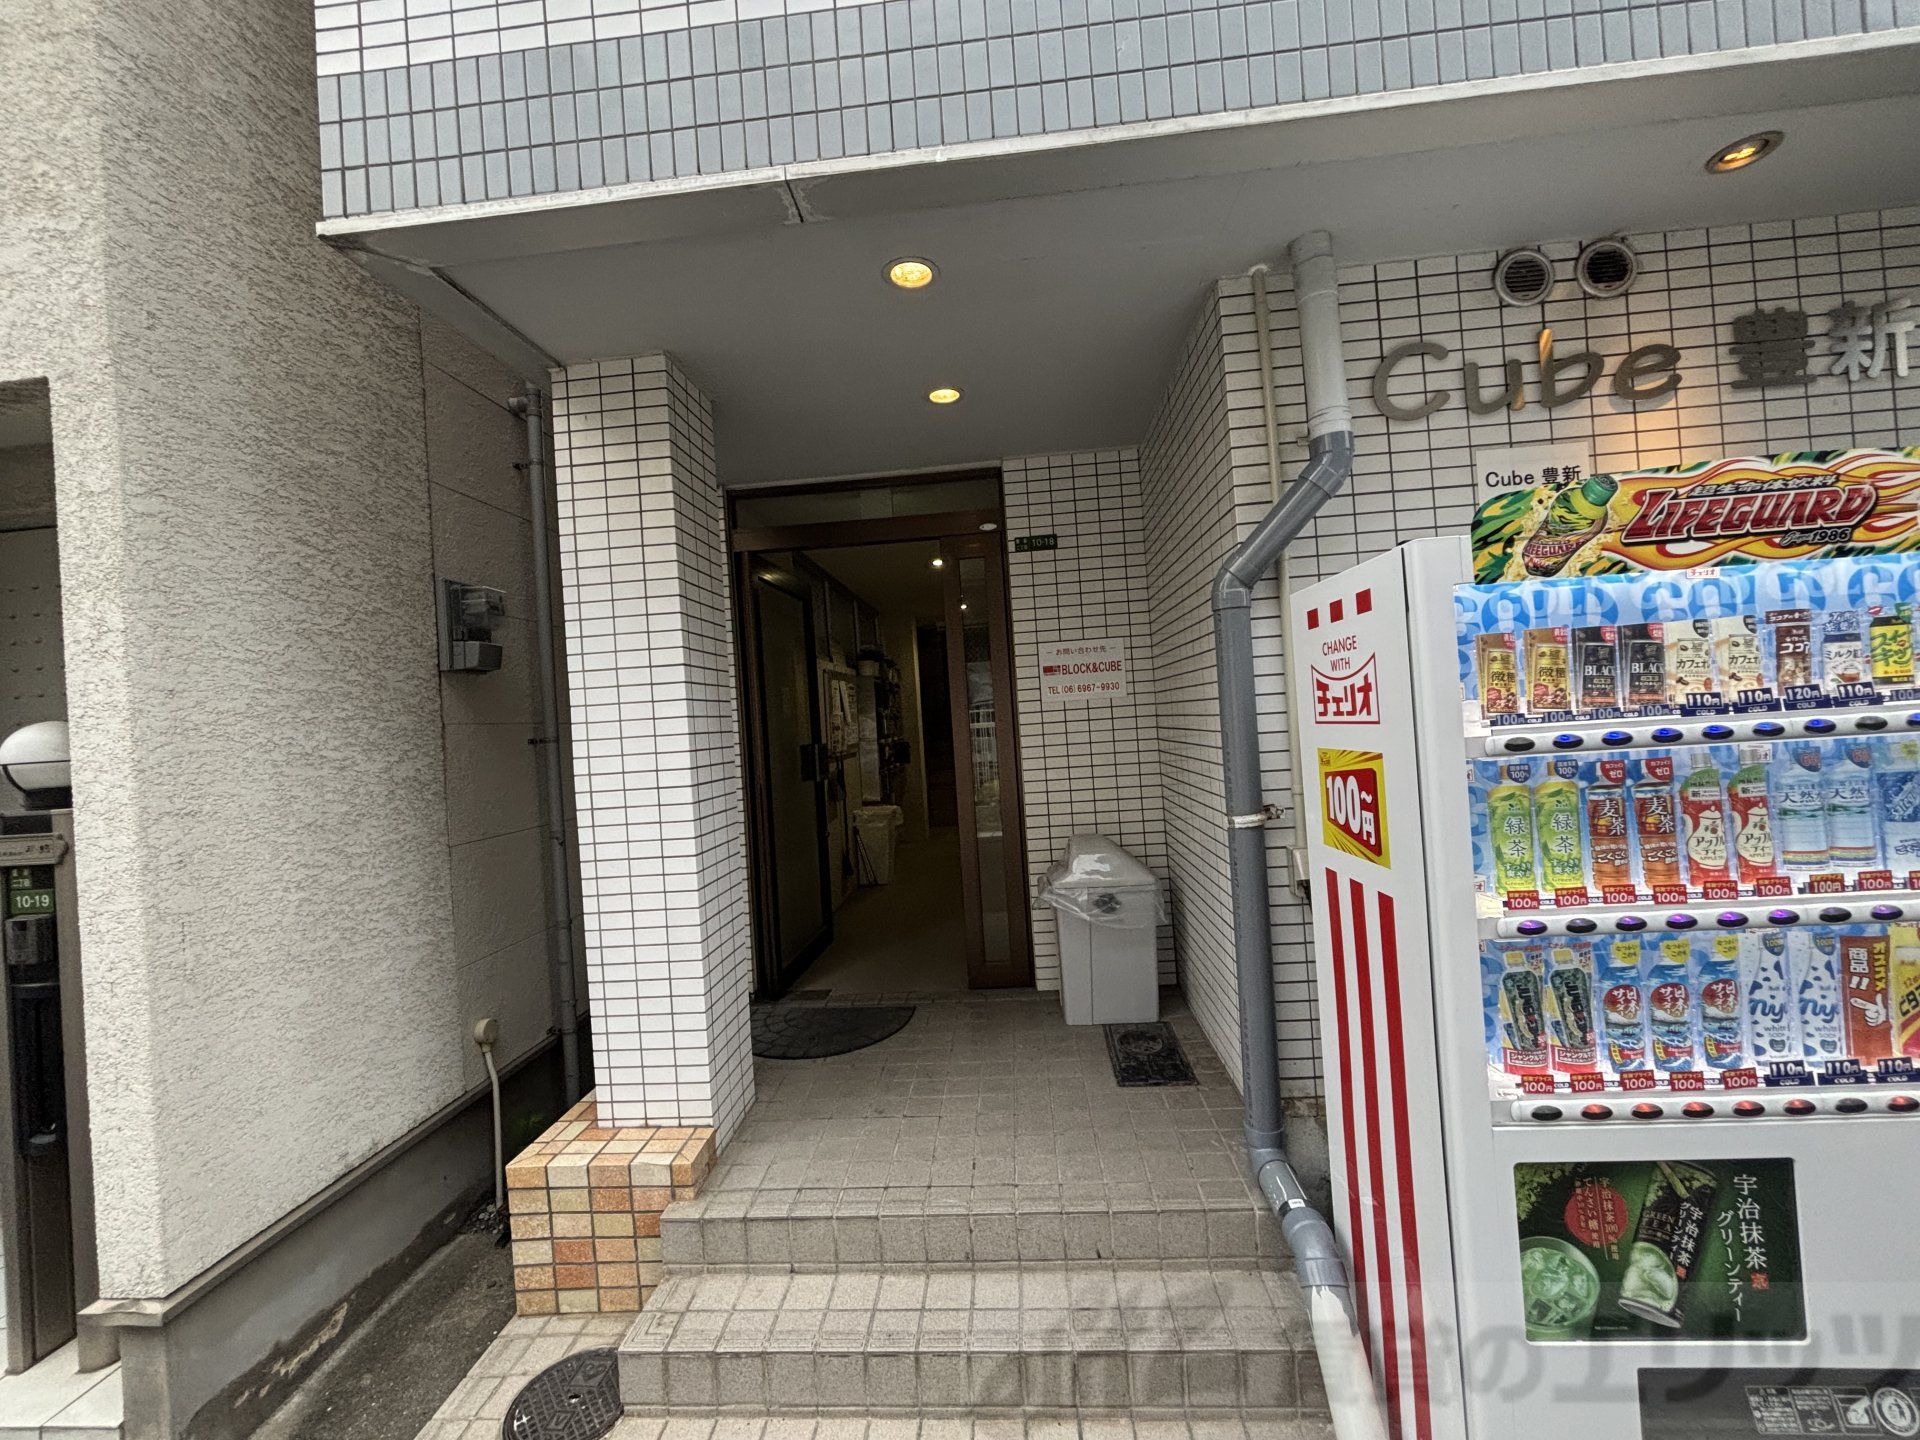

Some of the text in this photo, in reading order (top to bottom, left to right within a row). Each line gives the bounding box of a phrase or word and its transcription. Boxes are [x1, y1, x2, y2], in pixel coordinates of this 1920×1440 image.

[1373, 298, 1914, 421] Cube 豊新
[1485, 465, 1582, 488] Cube 豊新
[1690, 474, 1838, 498] 超生命体飲料
[1622, 483, 1877, 543] LIFEGUARD
[1811, 529, 1850, 544] 1986
[1322, 635, 1358, 657] CHANGE
[1061, 660, 1123, 676] BLOCK&CUBE
[1330, 657, 1351, 672] WITH
[1048, 686, 1061, 695] TEL
[1316, 673, 1373, 717] チェリオ
[1786, 688, 1820, 701] 120円
[1838, 685, 1871, 698] 110円
[1687, 695, 1720, 707] 110円
[1739, 691, 1771, 704] 110円
[1609, 770, 1623, 778] ゼロ
[1656, 767, 1670, 775] ゼロ
[1599, 800, 1625, 836] 麦茶
[1645, 798, 1675, 835] 麦茶
[1505, 817, 1527, 857] 緑茶
[1552, 814, 1574, 854] 緑茶
[1760, 884, 1790, 895] 100円
[1813, 880, 1842, 892] 100円
[1862, 878, 1891, 889] 100円
[1606, 892, 1634, 903] 100円
[1656, 892, 1685, 903] 100円
[1707, 888, 1736, 899] 100円
[16, 895, 50, 908] 10-19
[1509, 898, 1537, 908] 100円
[1558, 895, 1586, 906] 100円
[1771, 1065, 1803, 1077] 110円
[1827, 1063, 1859, 1075] 110円
[1880, 1060, 1912, 1073] 110円
[1524, 1082, 1552, 1093] 100円
[1573, 1080, 1602, 1091] 100円
[1624, 1078, 1653, 1089] 100円
[1673, 1079, 1703, 1090] 100円
[1726, 1076, 1757, 1087] 100円
[1643, 1219, 1673, 1232] TEA
[1733, 1174, 1768, 1270] 宇治抹茶
[1678, 1206, 1704, 1267] 宇治抹茶
[1716, 1209, 1743, 1322] グリーンティー
